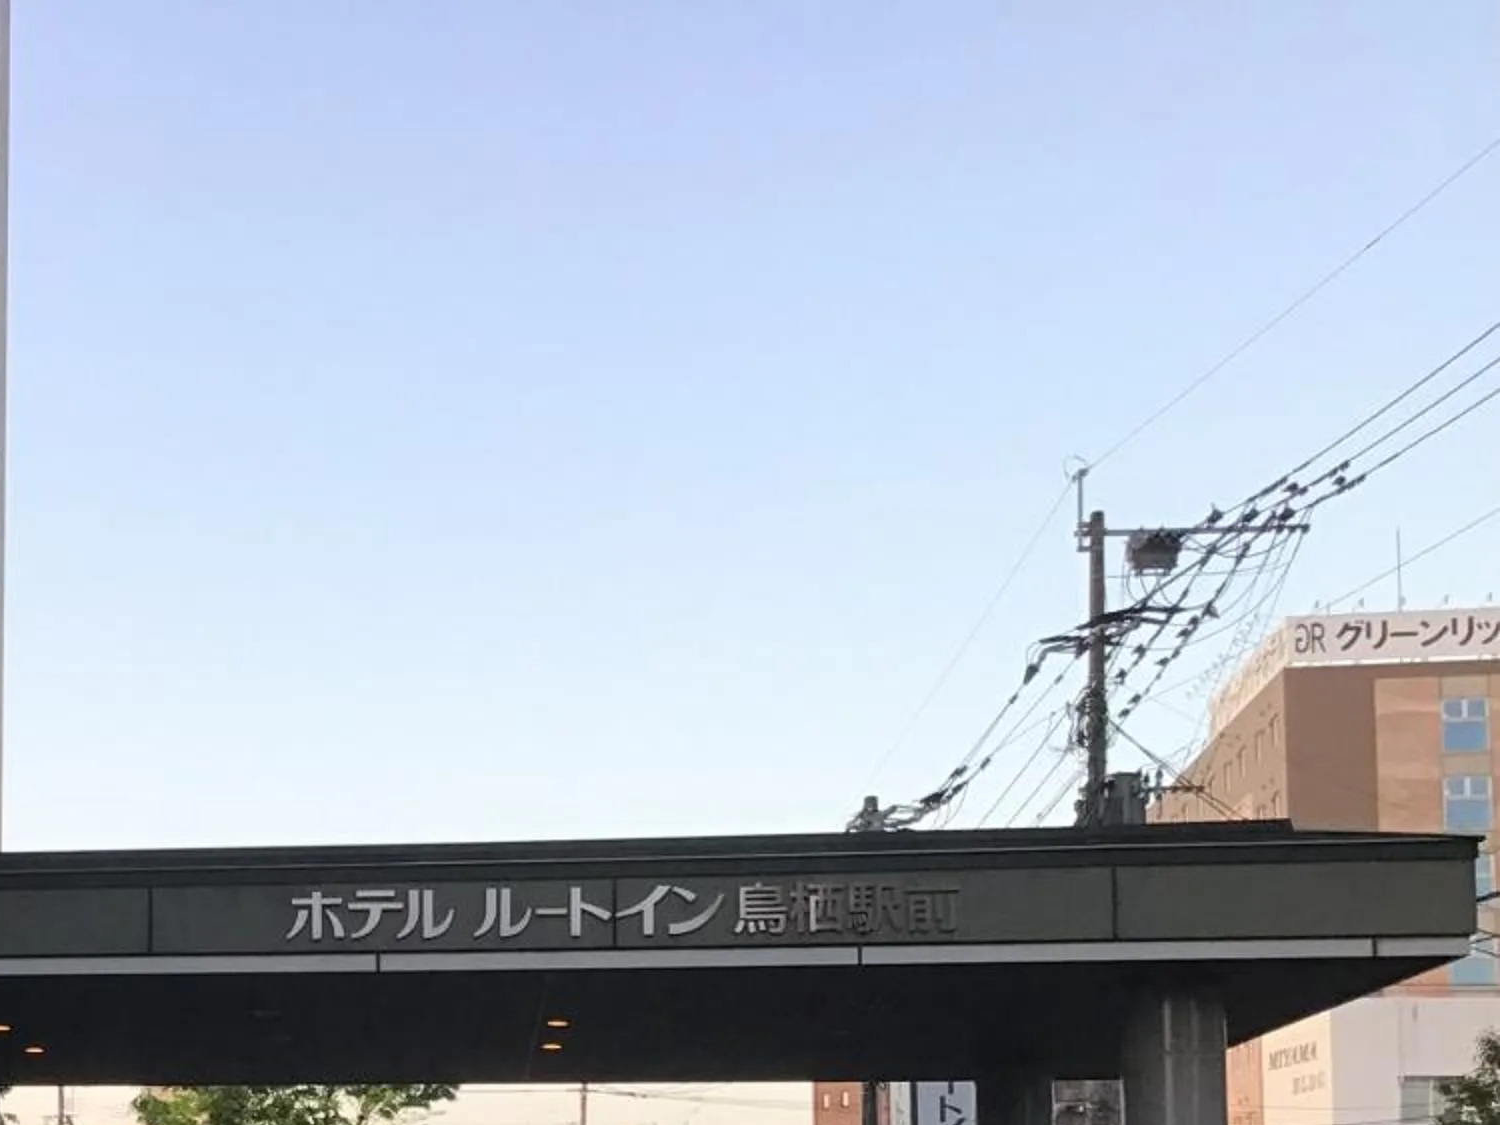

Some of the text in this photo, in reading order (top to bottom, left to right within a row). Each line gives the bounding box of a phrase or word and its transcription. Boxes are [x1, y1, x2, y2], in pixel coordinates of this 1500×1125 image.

[286, 881, 961, 941] ホテル ルートイン 鳥栖駅前
